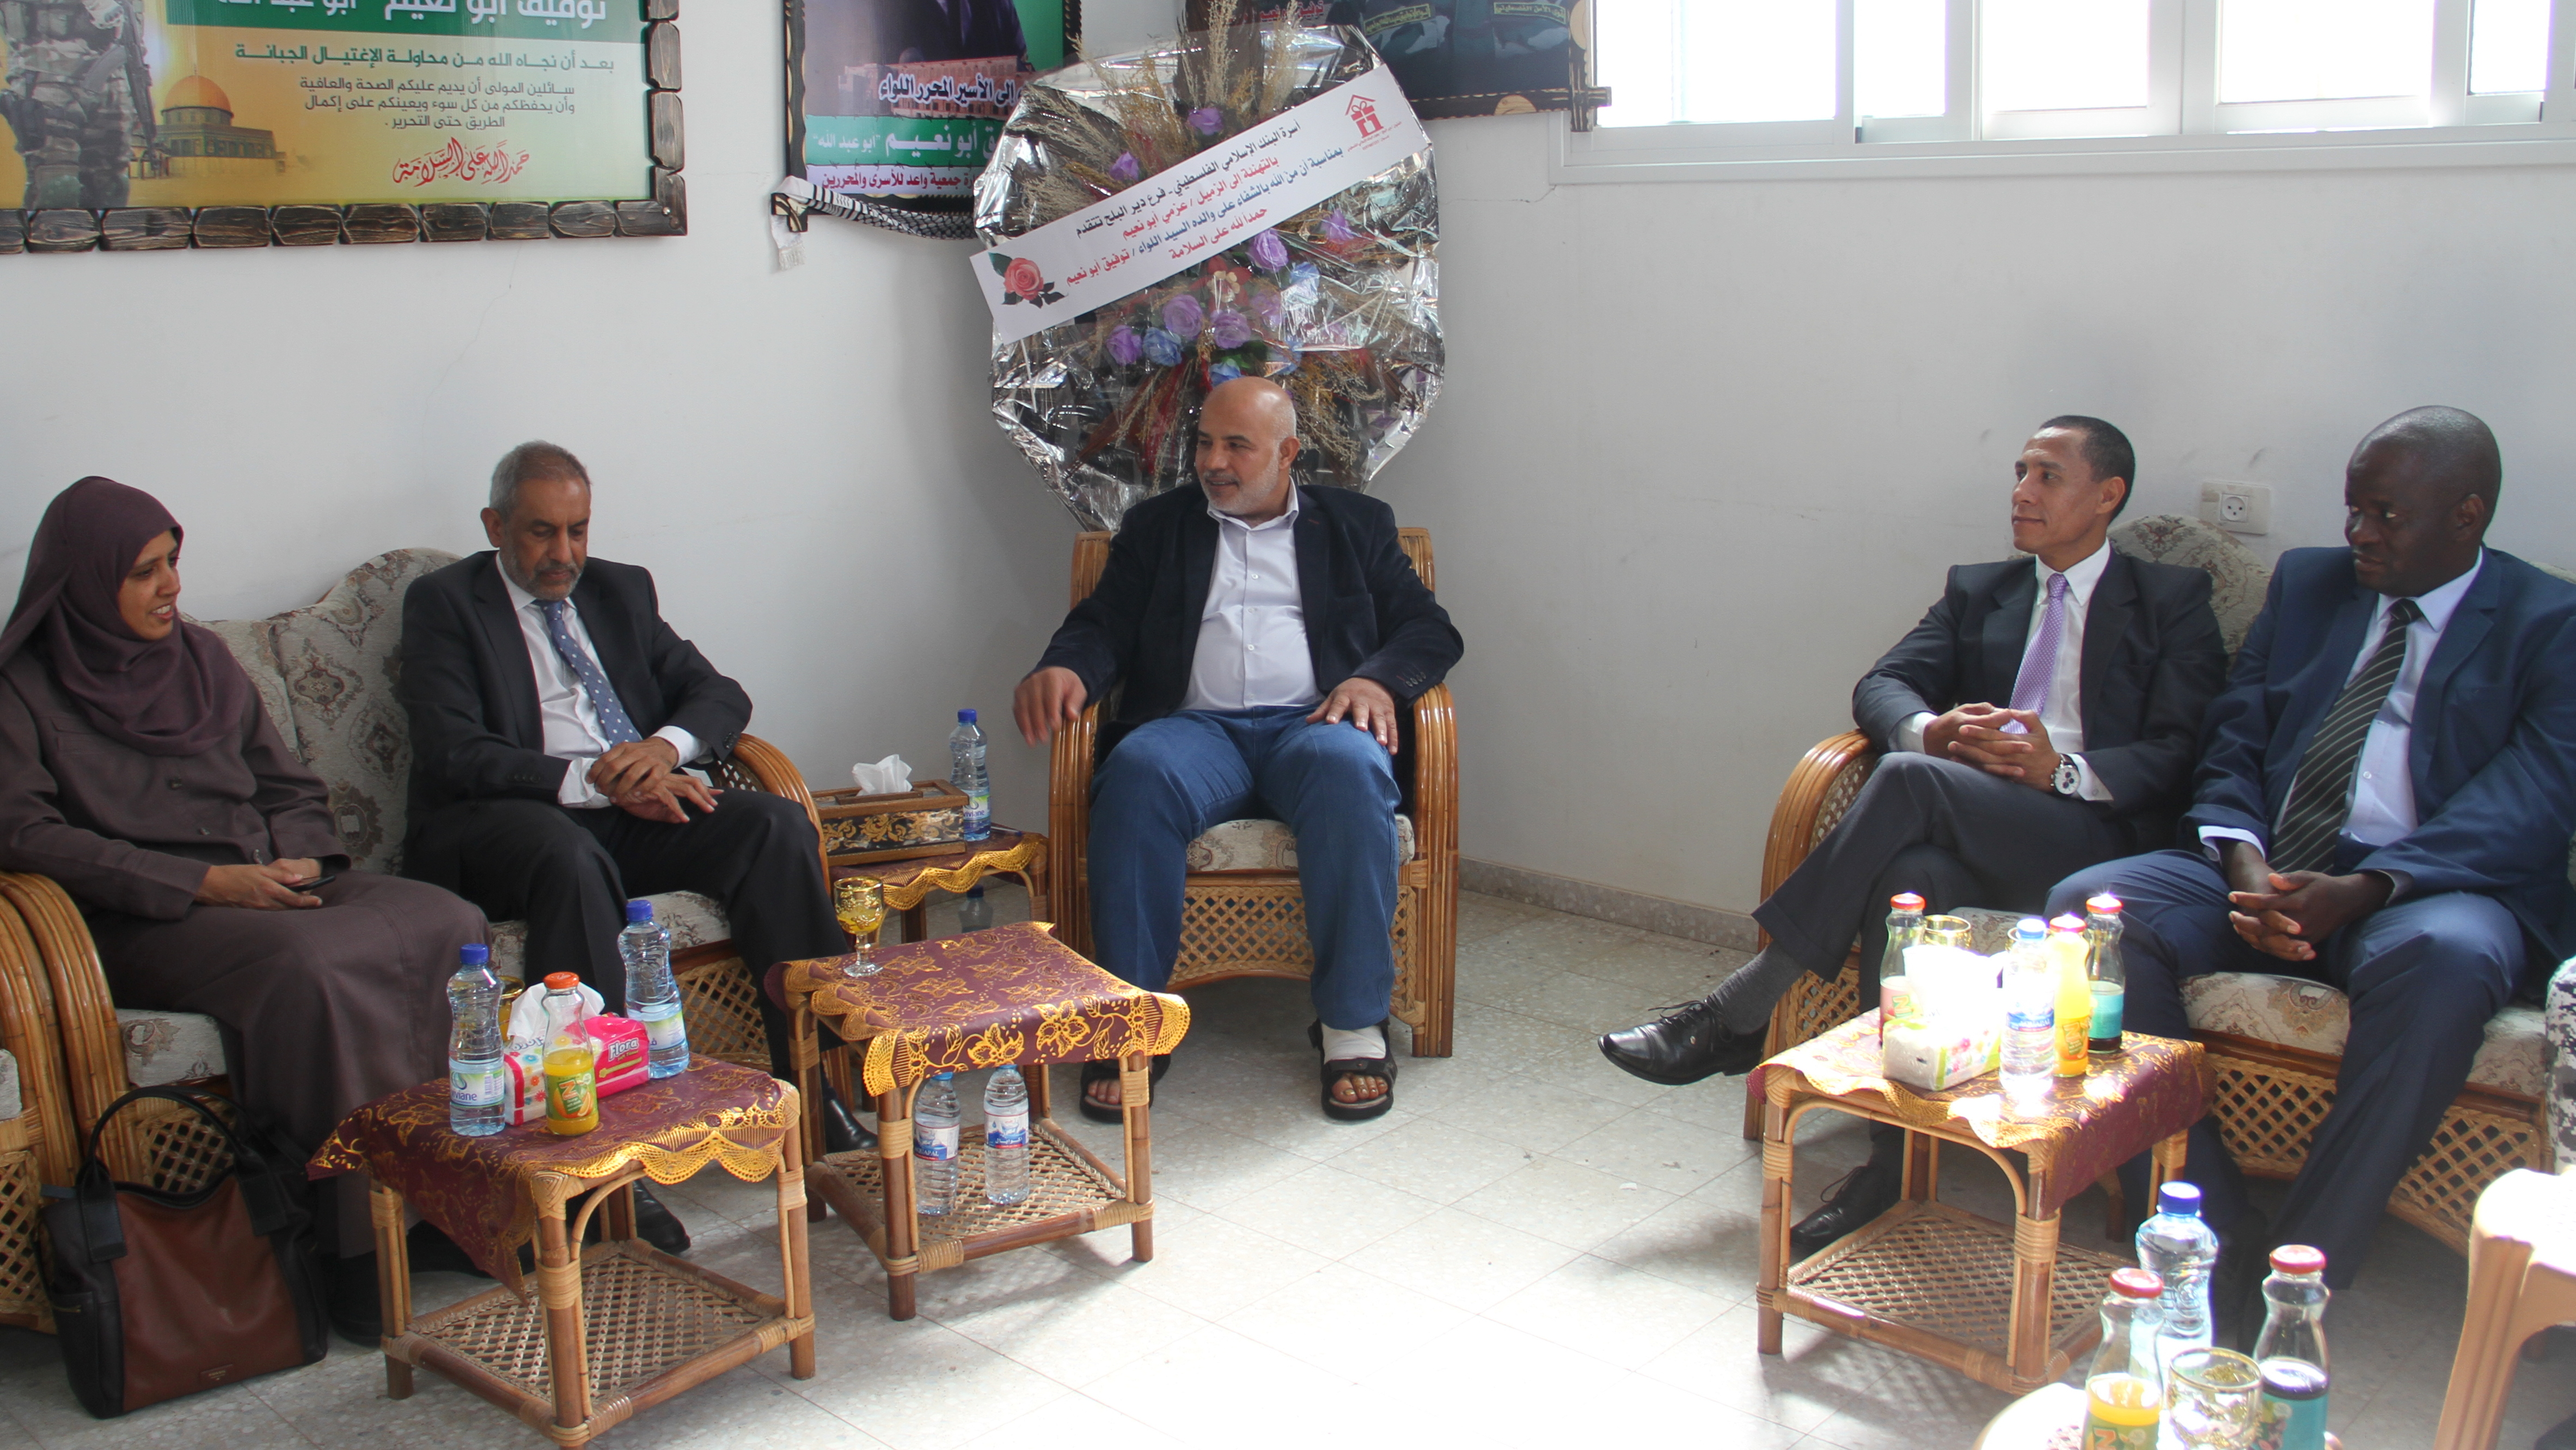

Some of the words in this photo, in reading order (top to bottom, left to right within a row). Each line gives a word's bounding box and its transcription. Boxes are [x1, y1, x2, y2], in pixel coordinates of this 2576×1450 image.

[235, 44, 307, 64] الجبانة
[312, 46, 382, 69] الإغتيال
[387, 49, 448, 68] محاولة
[452, 52, 484, 67] من
[488, 53, 512, 66] الله
[516, 54, 556, 71] نجاه
[560, 50, 576, 70] أن
[579, 59, 614, 74] بعد
[300, 77, 352, 92] والعافية
[357, 77, 393, 90] الصحة
[397, 79, 435, 94] عليكم
[438, 82, 464, 95] يديم
[468, 77, 481, 94] أن
[485, 82, 523, 95] المولى
[527, 82, 574, 97] سائلين
[879, 73, 915, 103] اللواء
[915, 76, 954, 104] المحرر
[957, 73, 994, 106] الأسير
[995, 79, 1014, 106] إلى
[305, 95, 341, 112] إكمال
[346, 96, 374, 110] على
[378, 97, 429, 113] ويعينكم
[432, 100, 457, 111] سوء
[461, 99, 477, 112] كل
[481, 100, 499, 112] من
[502, 98, 552, 114] يحفظكم
[555, 96, 575, 114] وأن
[391, 115, 430, 130] التحرير
[434, 116, 462, 130] حتى
[466, 116, 505, 130] الطريق
[1282, 119, 1301, 138] أسرة
[839, 136, 860, 153] عبد
[885, 125, 952, 157] نعيم
[954, 122, 978, 158] أبو
[1258, 131, 1281, 149] البنك
[1222, 143, 1257, 171] الإسلامي
[1308, 147, 1343, 169] بمناسبة
[1173, 160, 1219, 195] الفلسطيني
[1300, 160, 1309, 177] أن
[822, 172, 867, 189] والمحررين
[869, 169, 903, 189] للأسرى
[907, 172, 928, 189] واعد
[930, 172, 962, 189] جمعية
[1229, 172, 1241, 189] إلى
[1270, 173, 1284, 188] الله
[1147, 183, 1166, 206] فرع
[1197, 180, 1227, 205] الزميل
[1237, 182, 1270, 207] بالشفاء
[1104, 205, 1128, 226] البلح
[1131, 198, 1146, 216] دير
[1161, 201, 1188, 223] عزمي
[1217, 199, 1235, 218] على
[1076, 215, 1103, 238] تتقدم
[1147, 211, 1159, 231] أبو
[1192, 210, 1216, 228] والده
[1230, 215, 1244, 231] لله
[1122, 219, 1145, 241] نعيم
[1164, 221, 1190, 242] السيد
[1210, 226, 1229, 244] على
[1138, 233, 1162, 255] اللواء
[1168, 234, 1208, 260] السلامة
[1103, 248, 1130, 272] توفيق
[1066, 267, 1087, 286] نعيم
[1089, 260, 1101, 279] أبو
[608, 1038, 639, 1061] Flora
